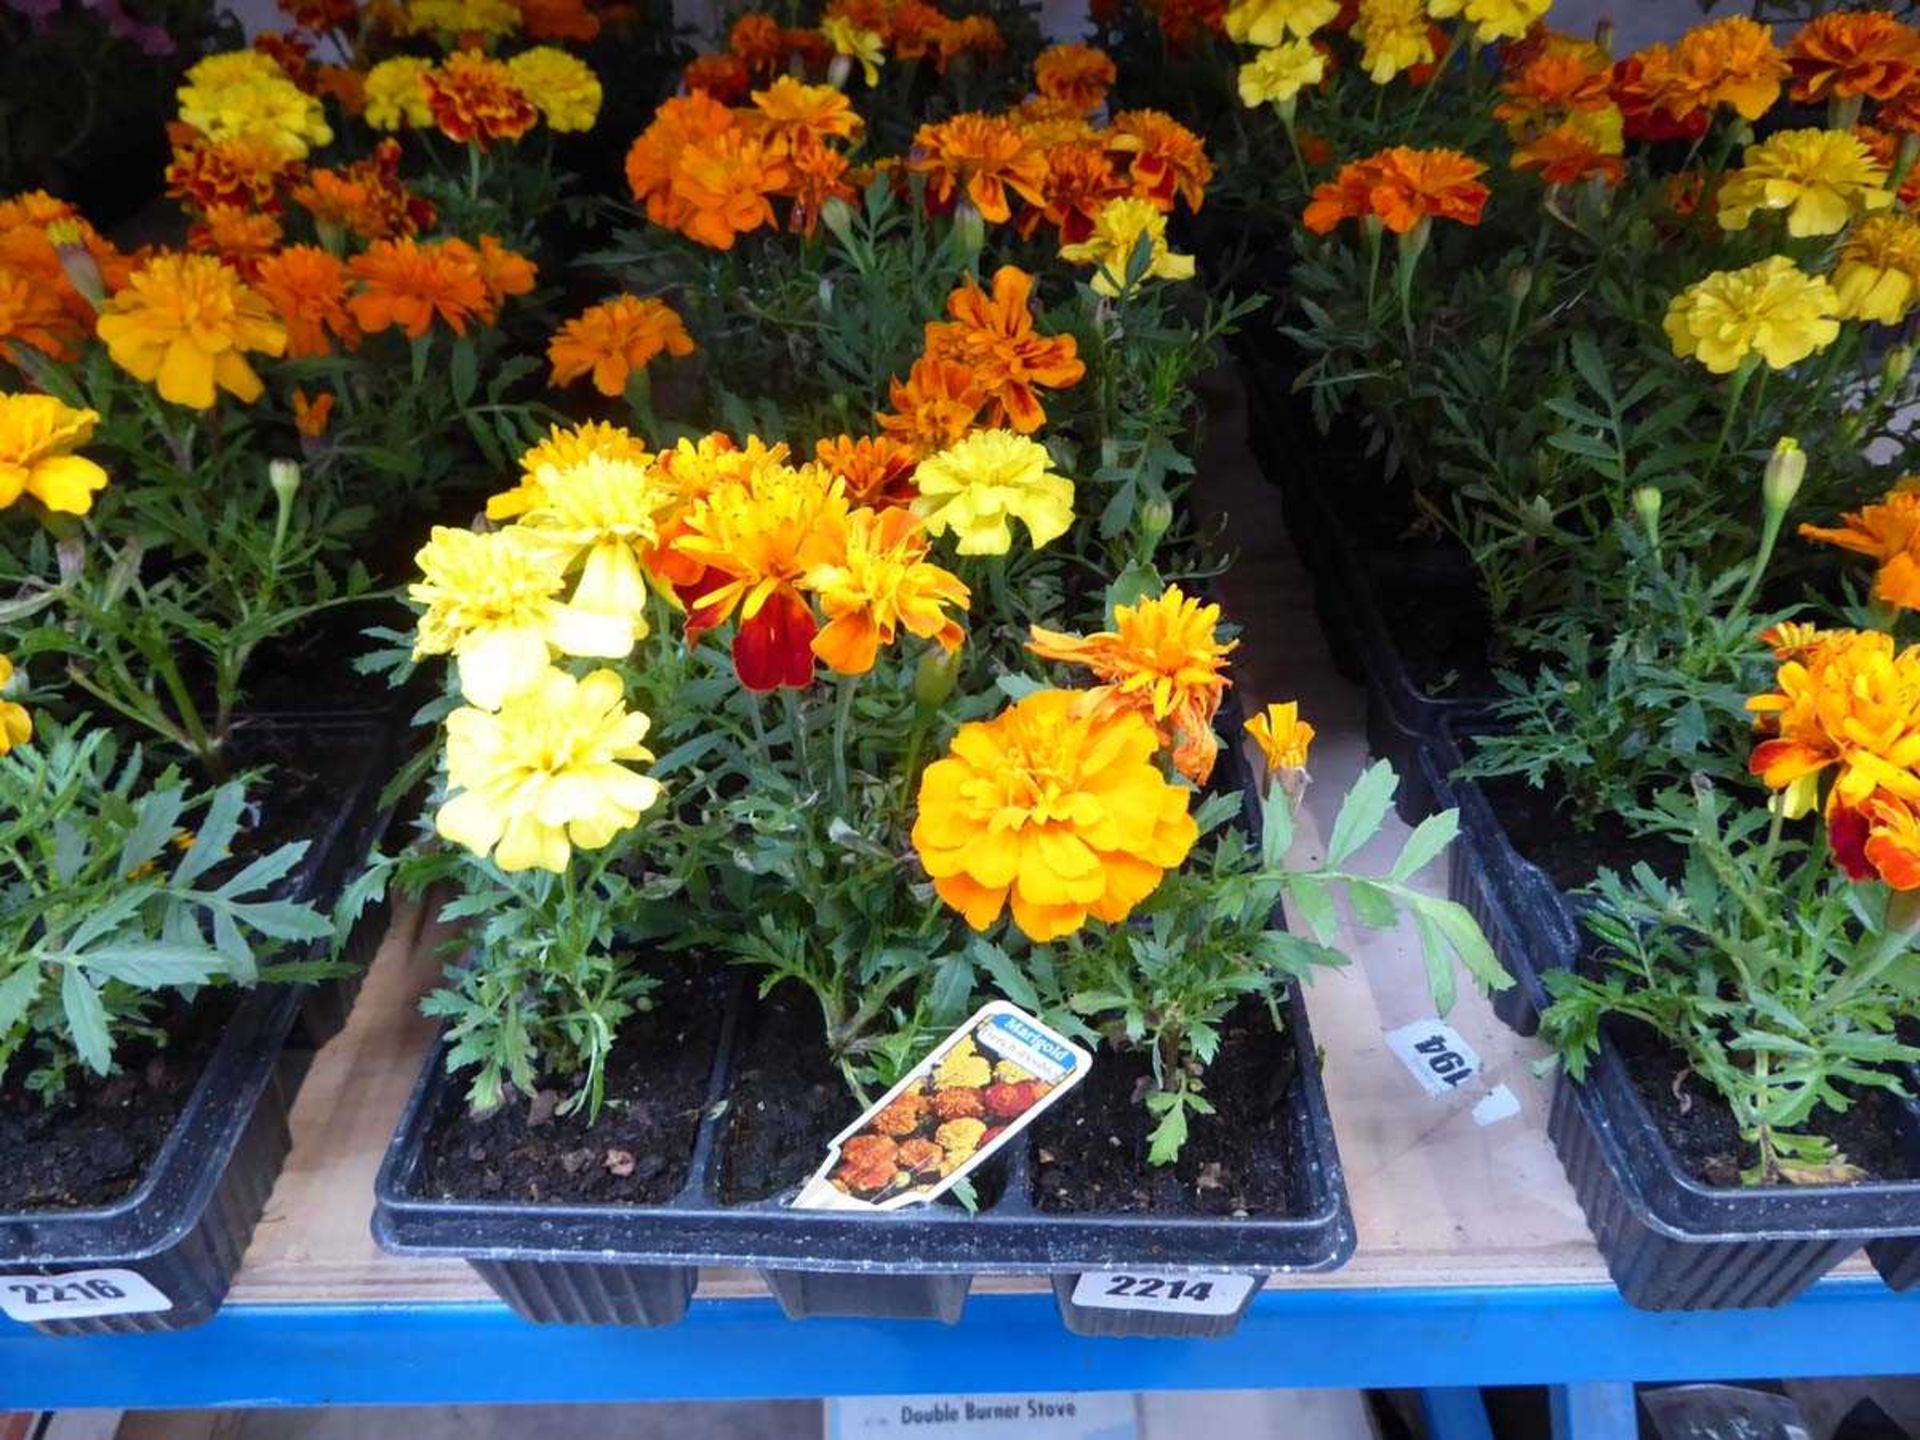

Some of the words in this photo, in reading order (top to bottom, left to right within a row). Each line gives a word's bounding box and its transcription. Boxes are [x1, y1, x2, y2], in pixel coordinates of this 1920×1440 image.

[1003, 1017, 1067, 1061] Marigold
[8, 1278, 126, 1304] 2216
[1105, 1275, 1214, 1301] 2214
[901, 1401, 959, 1424] Double
[965, 1400, 1020, 1420] Burner
[1027, 1399, 1076, 1418] Stove
